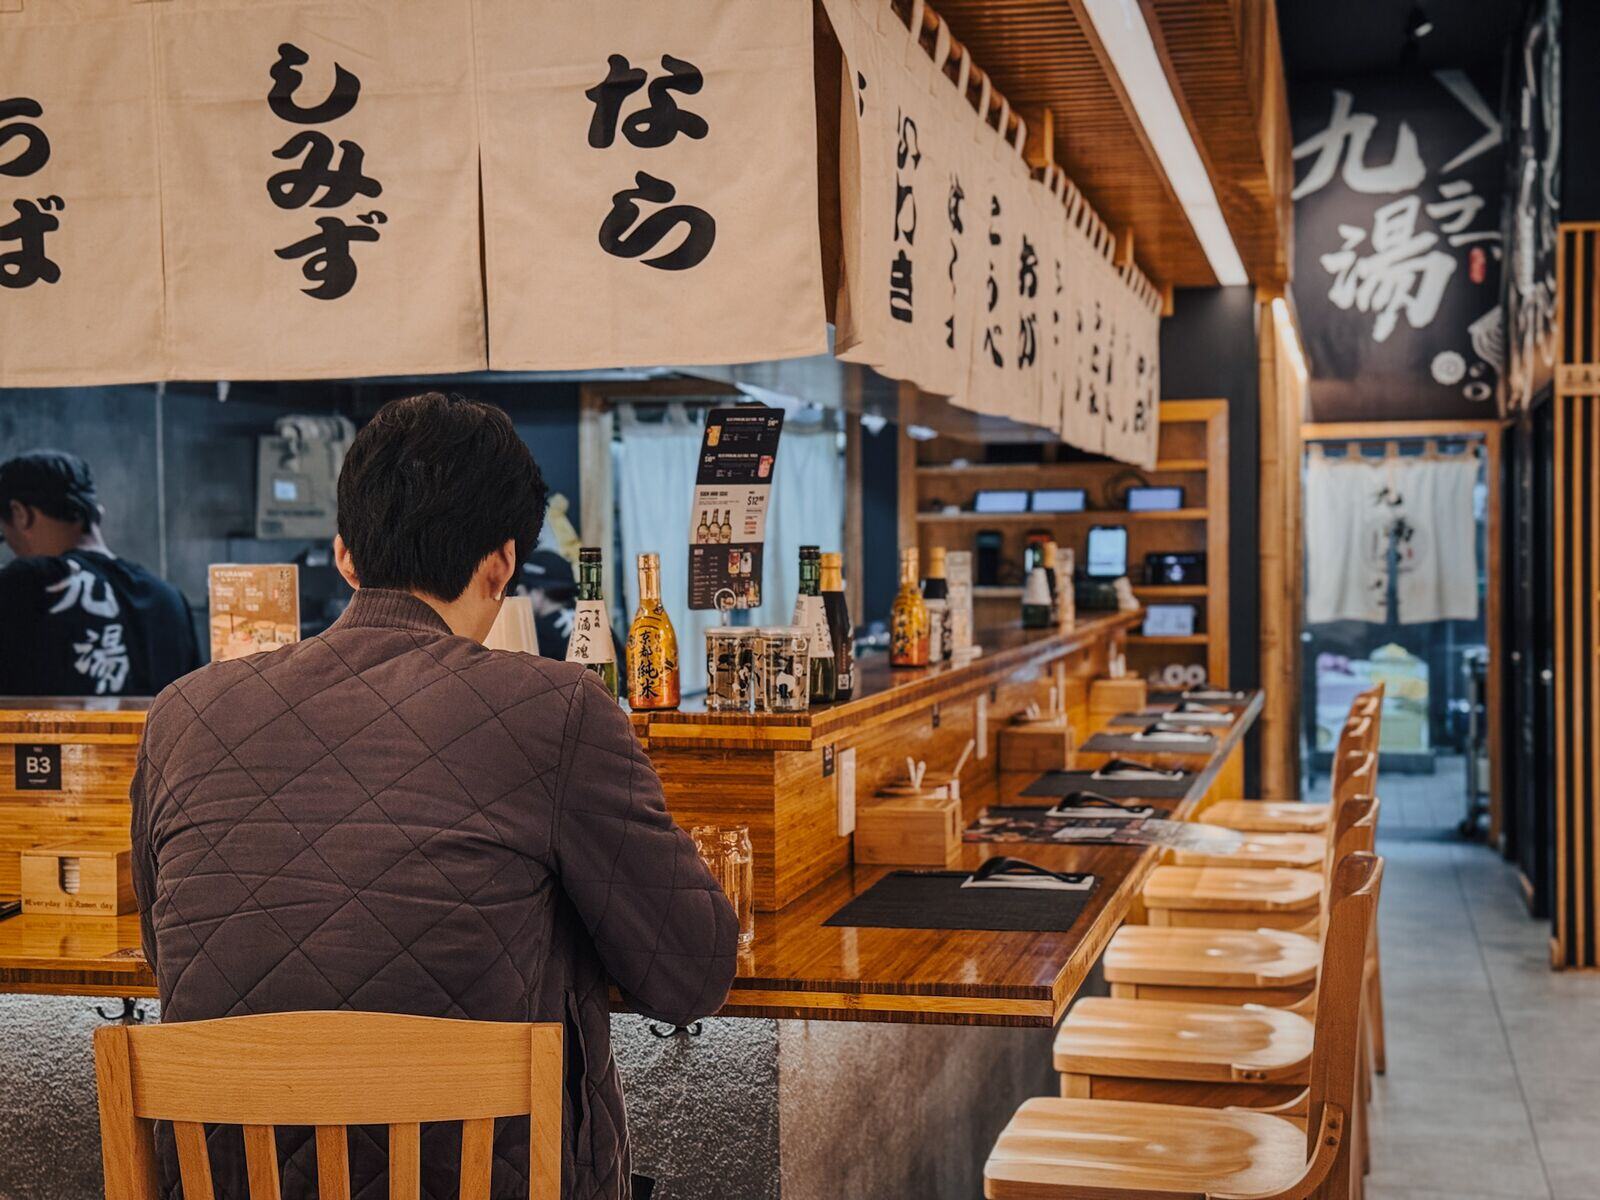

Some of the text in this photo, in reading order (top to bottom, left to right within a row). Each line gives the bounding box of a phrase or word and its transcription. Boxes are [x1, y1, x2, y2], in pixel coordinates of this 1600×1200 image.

[266, 42, 388, 301] しみず
[585, 53, 716, 272] なら
[46, 558, 131, 695] 九湯
[637, 629, 659, 699] 京都純米
[26, 756, 51, 774] B3
[100, 902, 114, 910] day
